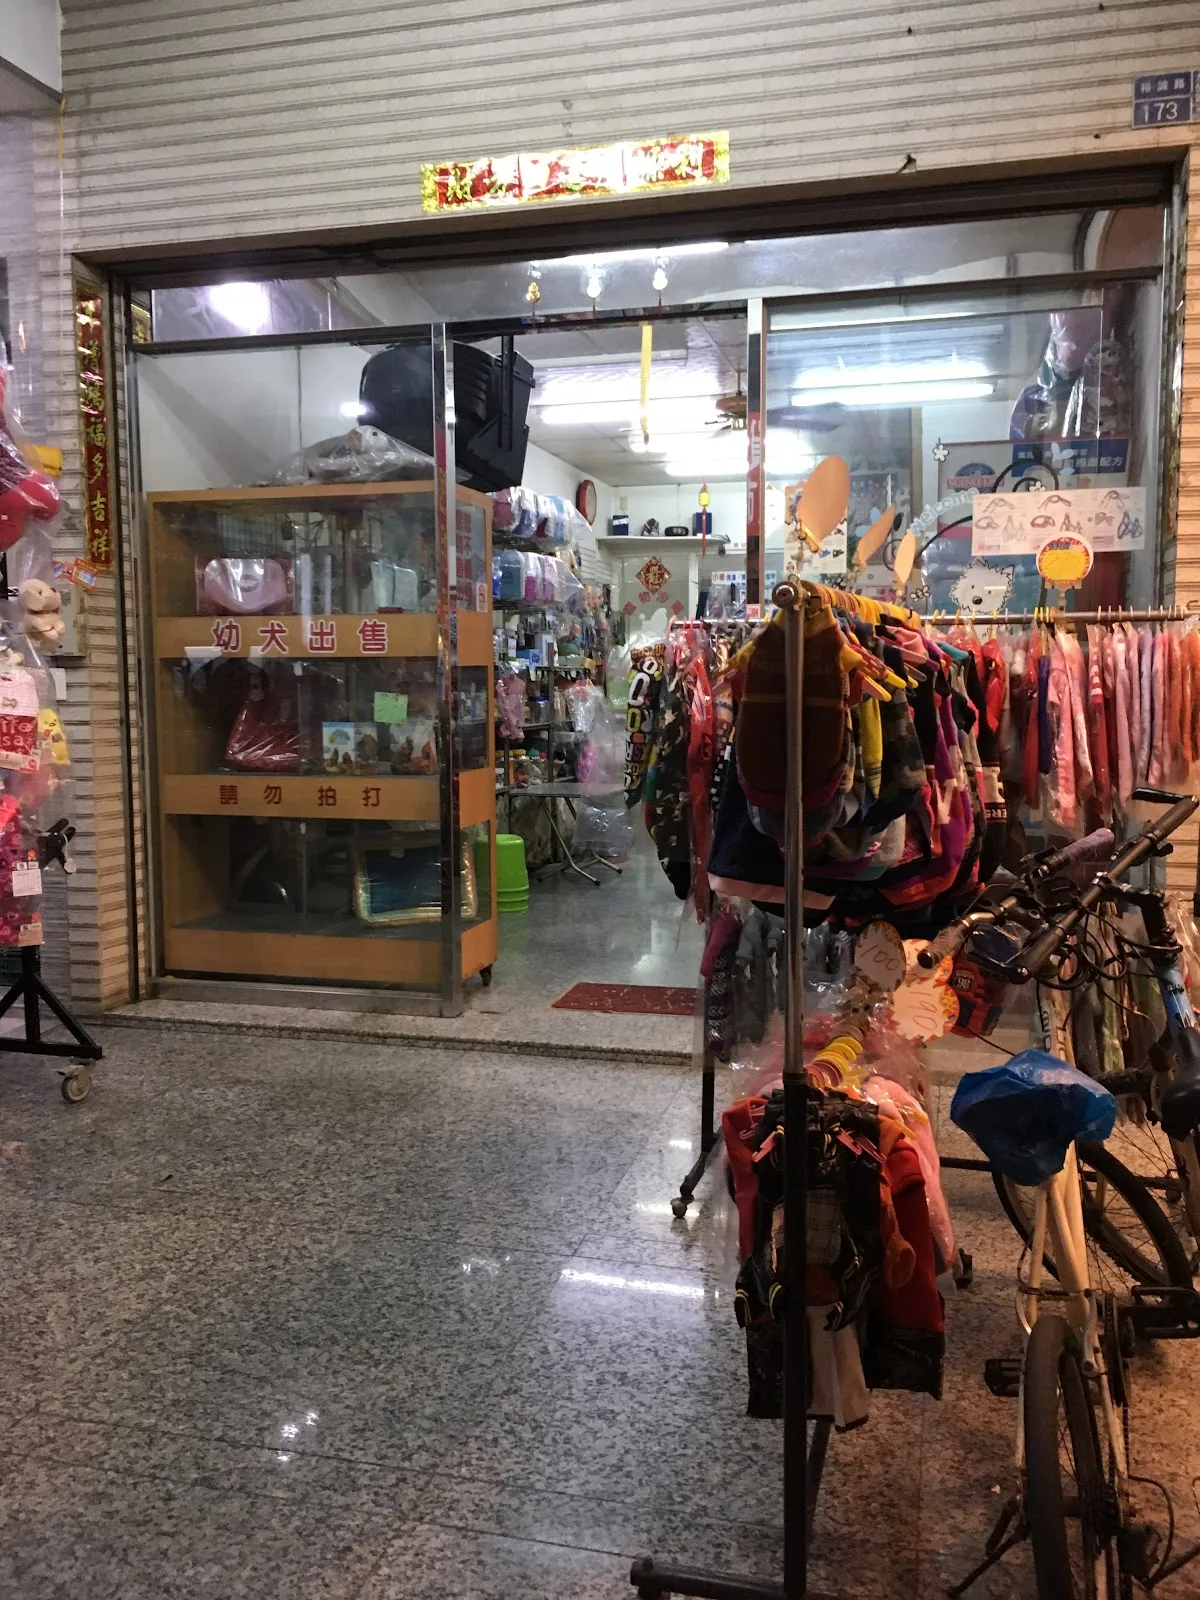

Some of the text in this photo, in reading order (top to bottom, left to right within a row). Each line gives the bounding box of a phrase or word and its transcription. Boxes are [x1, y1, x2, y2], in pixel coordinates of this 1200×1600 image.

[1141, 101, 1178, 122] 173
[213, 619, 387, 653] 幼犬出售
[219, 784, 382, 807] 請勿拍打
[860, 944, 899, 971] 100
[908, 990, 938, 1030] 190
